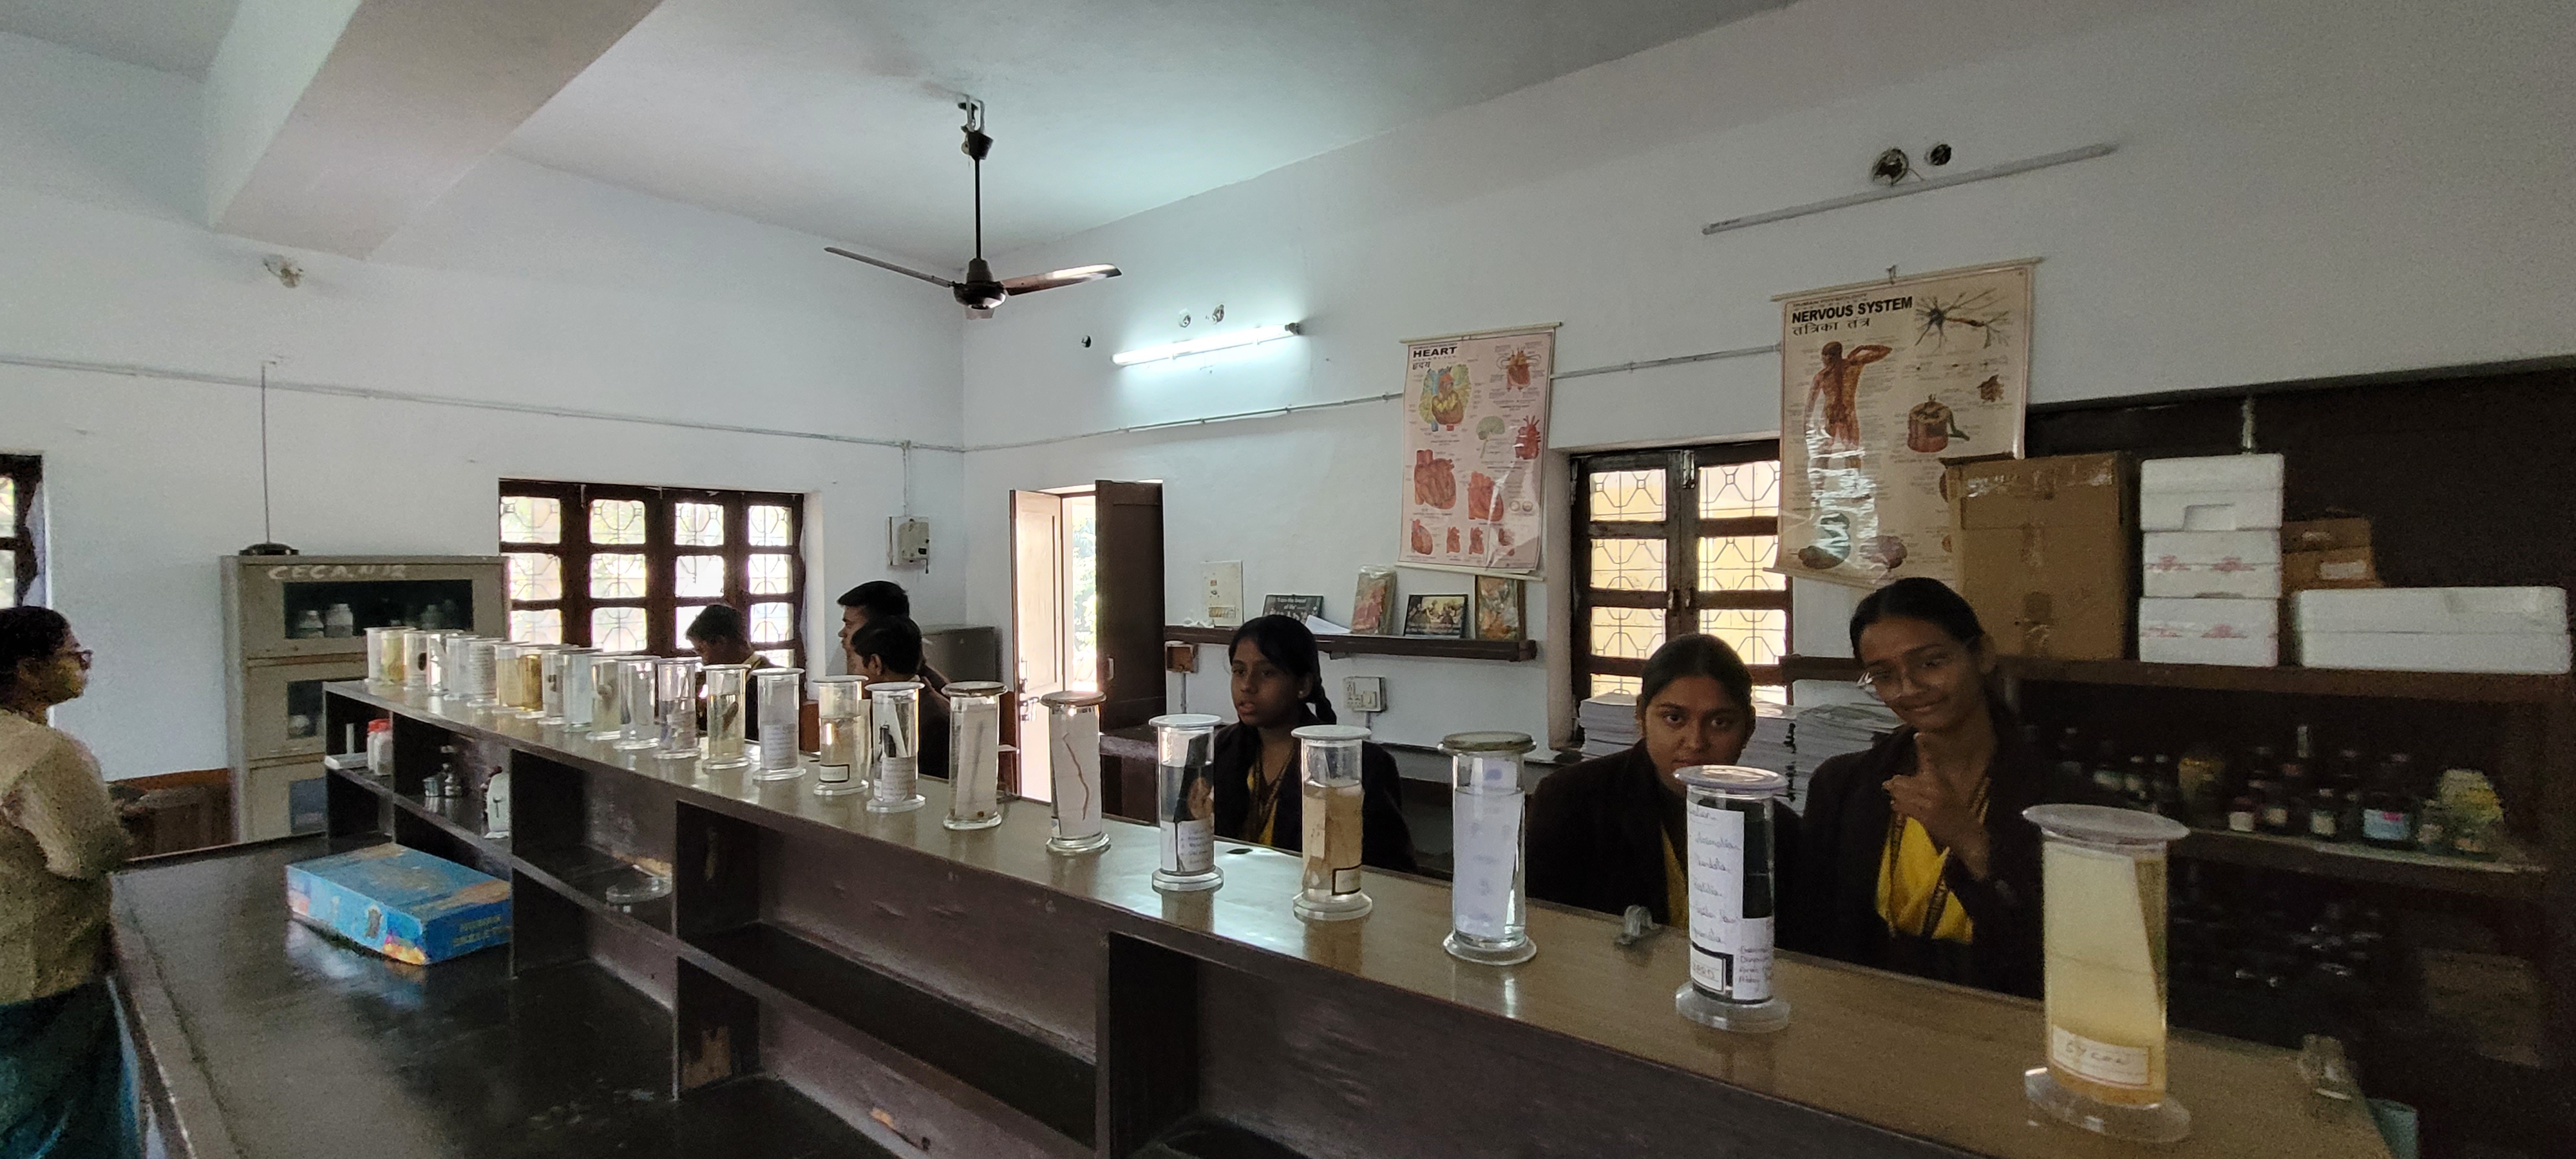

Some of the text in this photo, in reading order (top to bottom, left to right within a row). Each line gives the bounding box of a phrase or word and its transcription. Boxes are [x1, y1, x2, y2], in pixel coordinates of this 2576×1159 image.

[1792, 305, 1853, 324] NERVOUS
[1857, 296, 1913, 315] SYSTEM
[1792, 316, 1871, 336] तंत्रिका तंत्र
[1413, 346, 1458, 358] HEART
